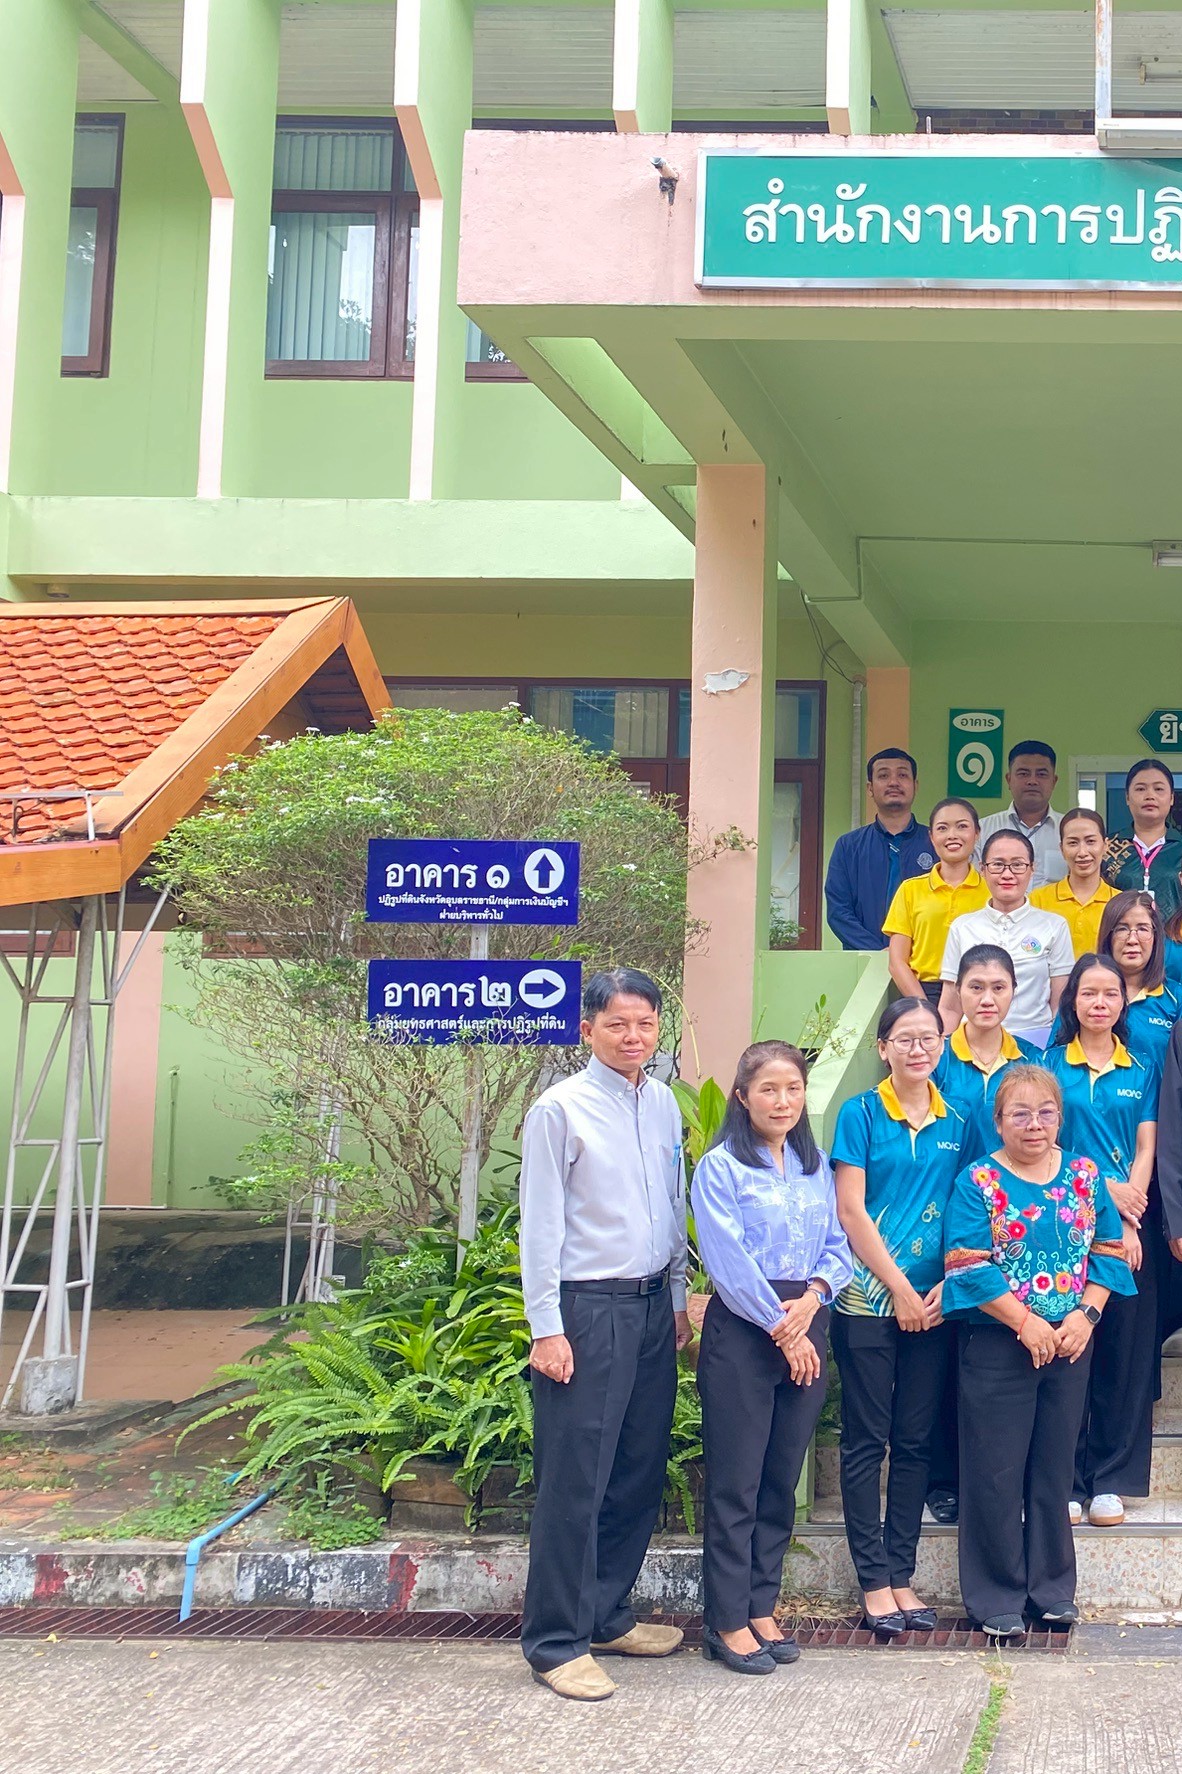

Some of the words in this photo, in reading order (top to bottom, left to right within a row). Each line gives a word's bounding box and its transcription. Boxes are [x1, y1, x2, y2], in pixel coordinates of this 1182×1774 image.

[960, 718, 995, 727] อาคาร
[956, 741, 995, 788] ๑
[385, 862, 479, 889] อาคาร
[486, 864, 511, 889] ๑
